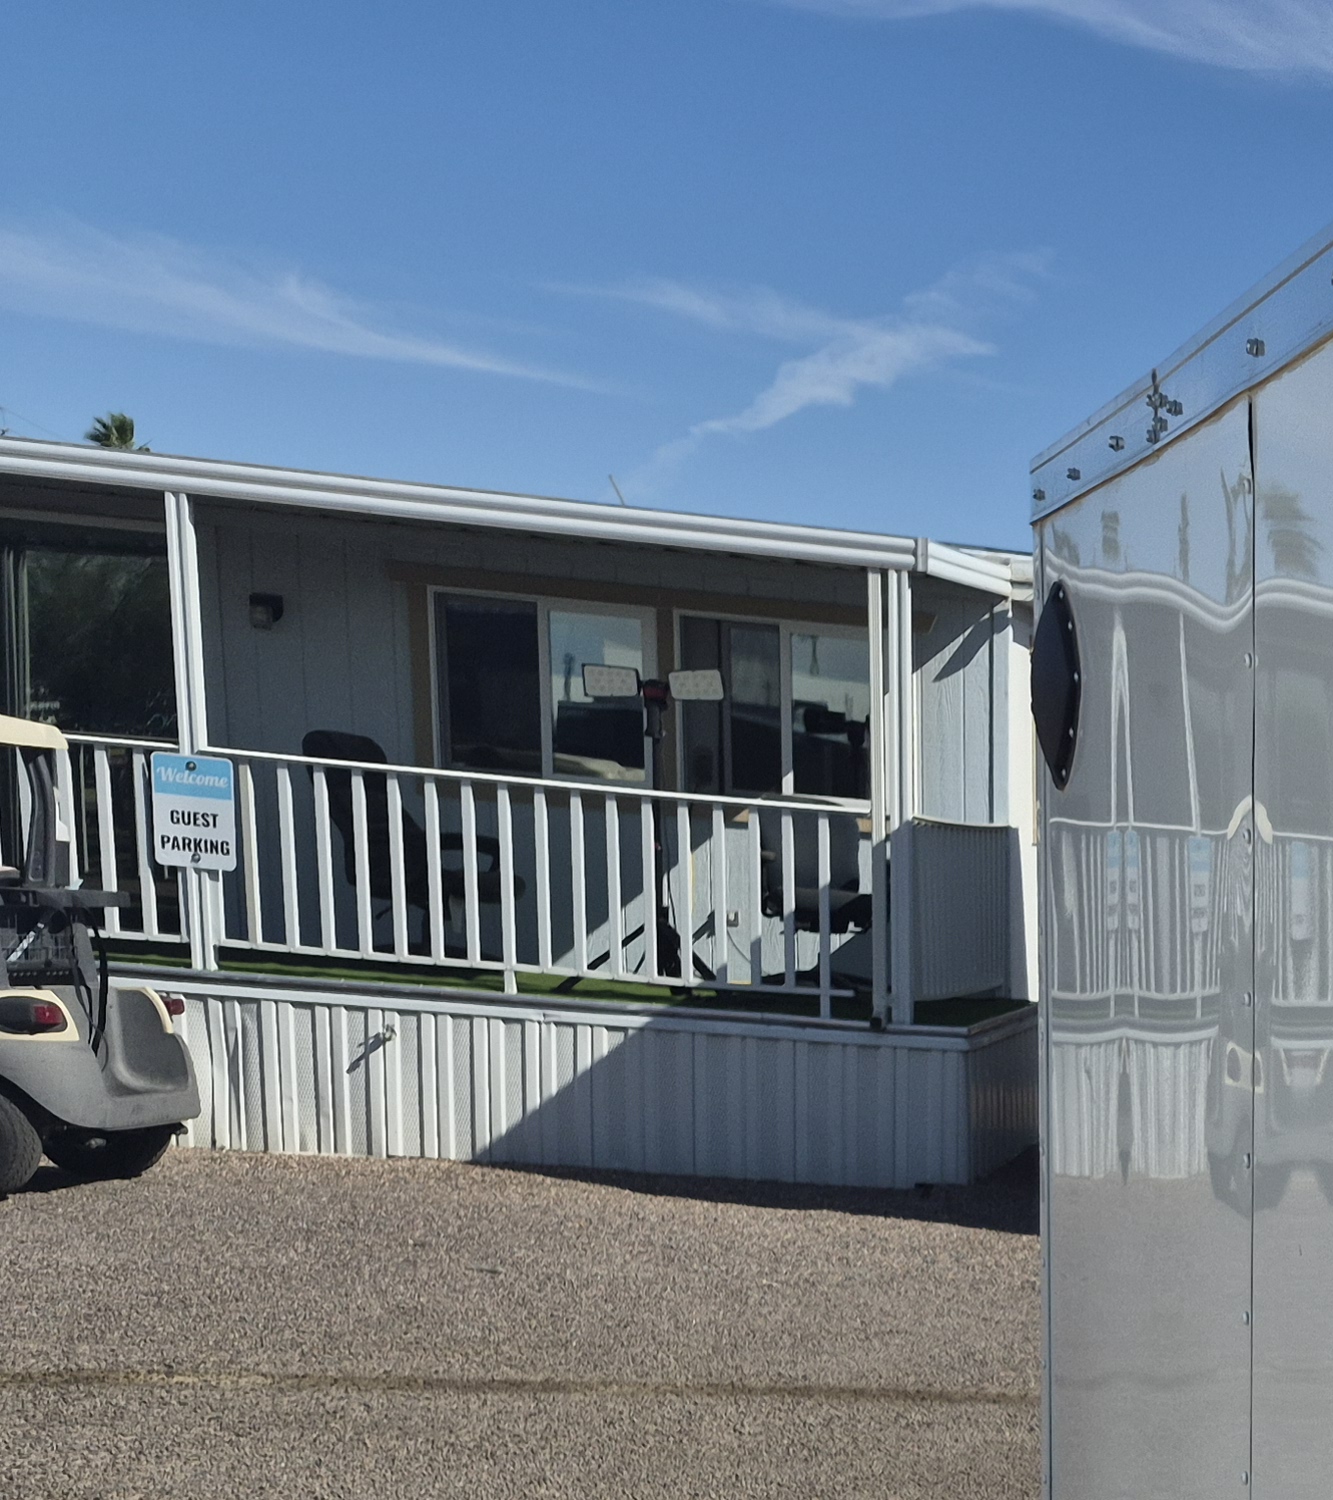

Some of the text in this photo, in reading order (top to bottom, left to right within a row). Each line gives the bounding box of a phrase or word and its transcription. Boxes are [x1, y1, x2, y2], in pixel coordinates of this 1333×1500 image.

[156, 766, 229, 787] Welcome
[169, 809, 219, 828] GUEST
[160, 834, 230, 856] PARKING
